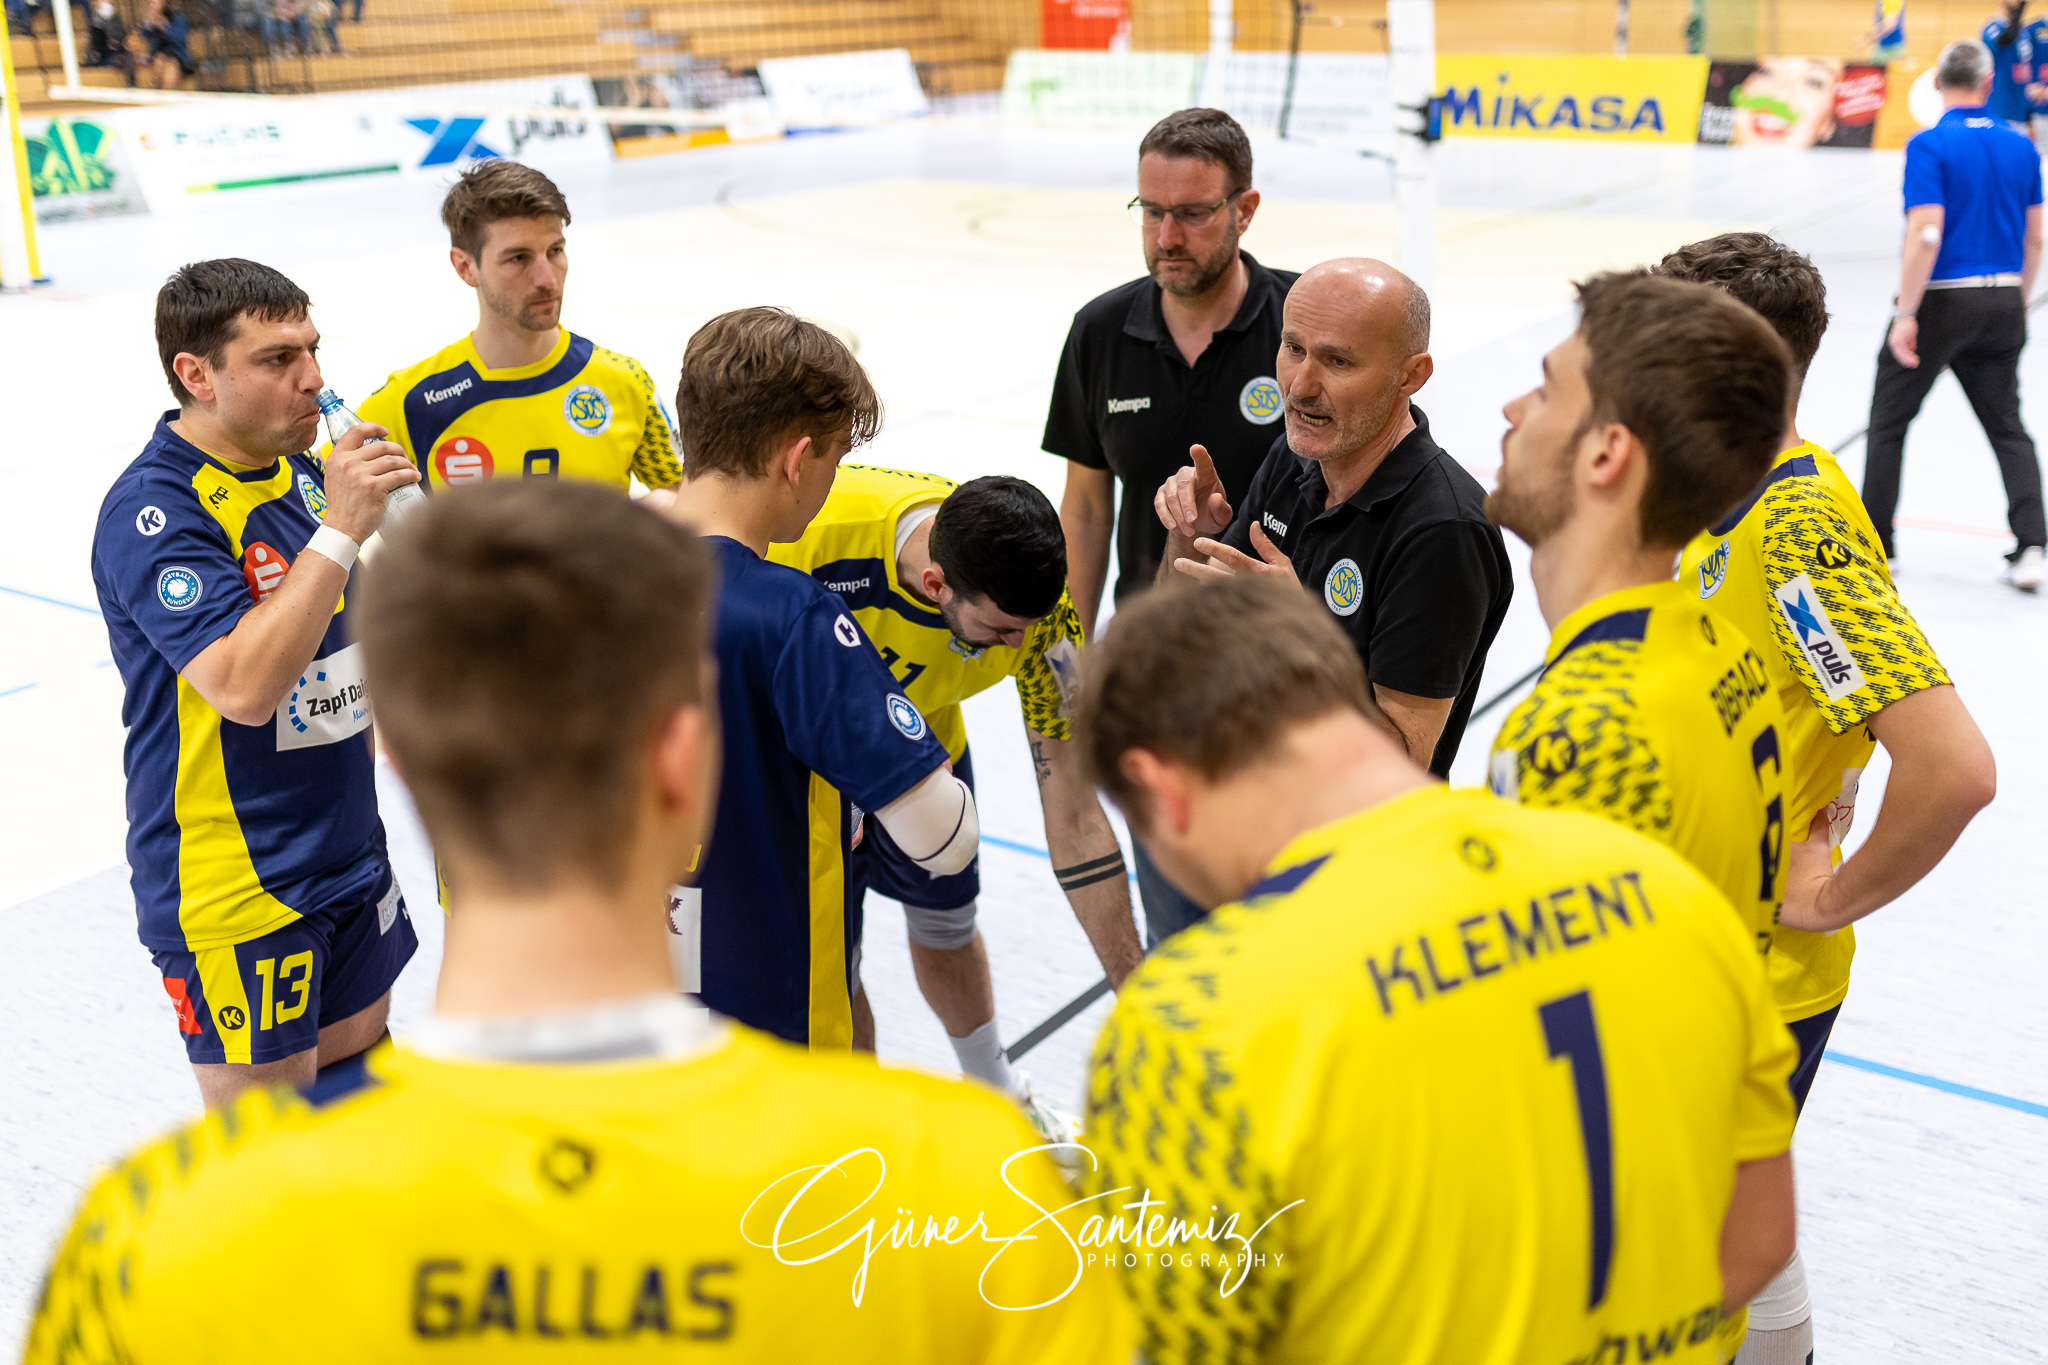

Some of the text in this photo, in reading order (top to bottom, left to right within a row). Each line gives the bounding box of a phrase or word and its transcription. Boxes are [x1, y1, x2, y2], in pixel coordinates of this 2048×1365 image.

[423, 377, 473, 405] Kempa
[1108, 397, 1151, 413] Kempa
[161, 571, 191, 593] VOLLEYBALL
[166, 586, 197, 606] BUNDESLIGA
[824, 577, 870, 593] empa
[1807, 640, 1852, 684] puls
[306, 688, 348, 717] Zapf
[1367, 871, 1655, 1016] KLEMENT
[255, 949, 314, 1031] 13
[1538, 988, 1616, 1313] 1
[412, 1258, 737, 1341] GALLAS
